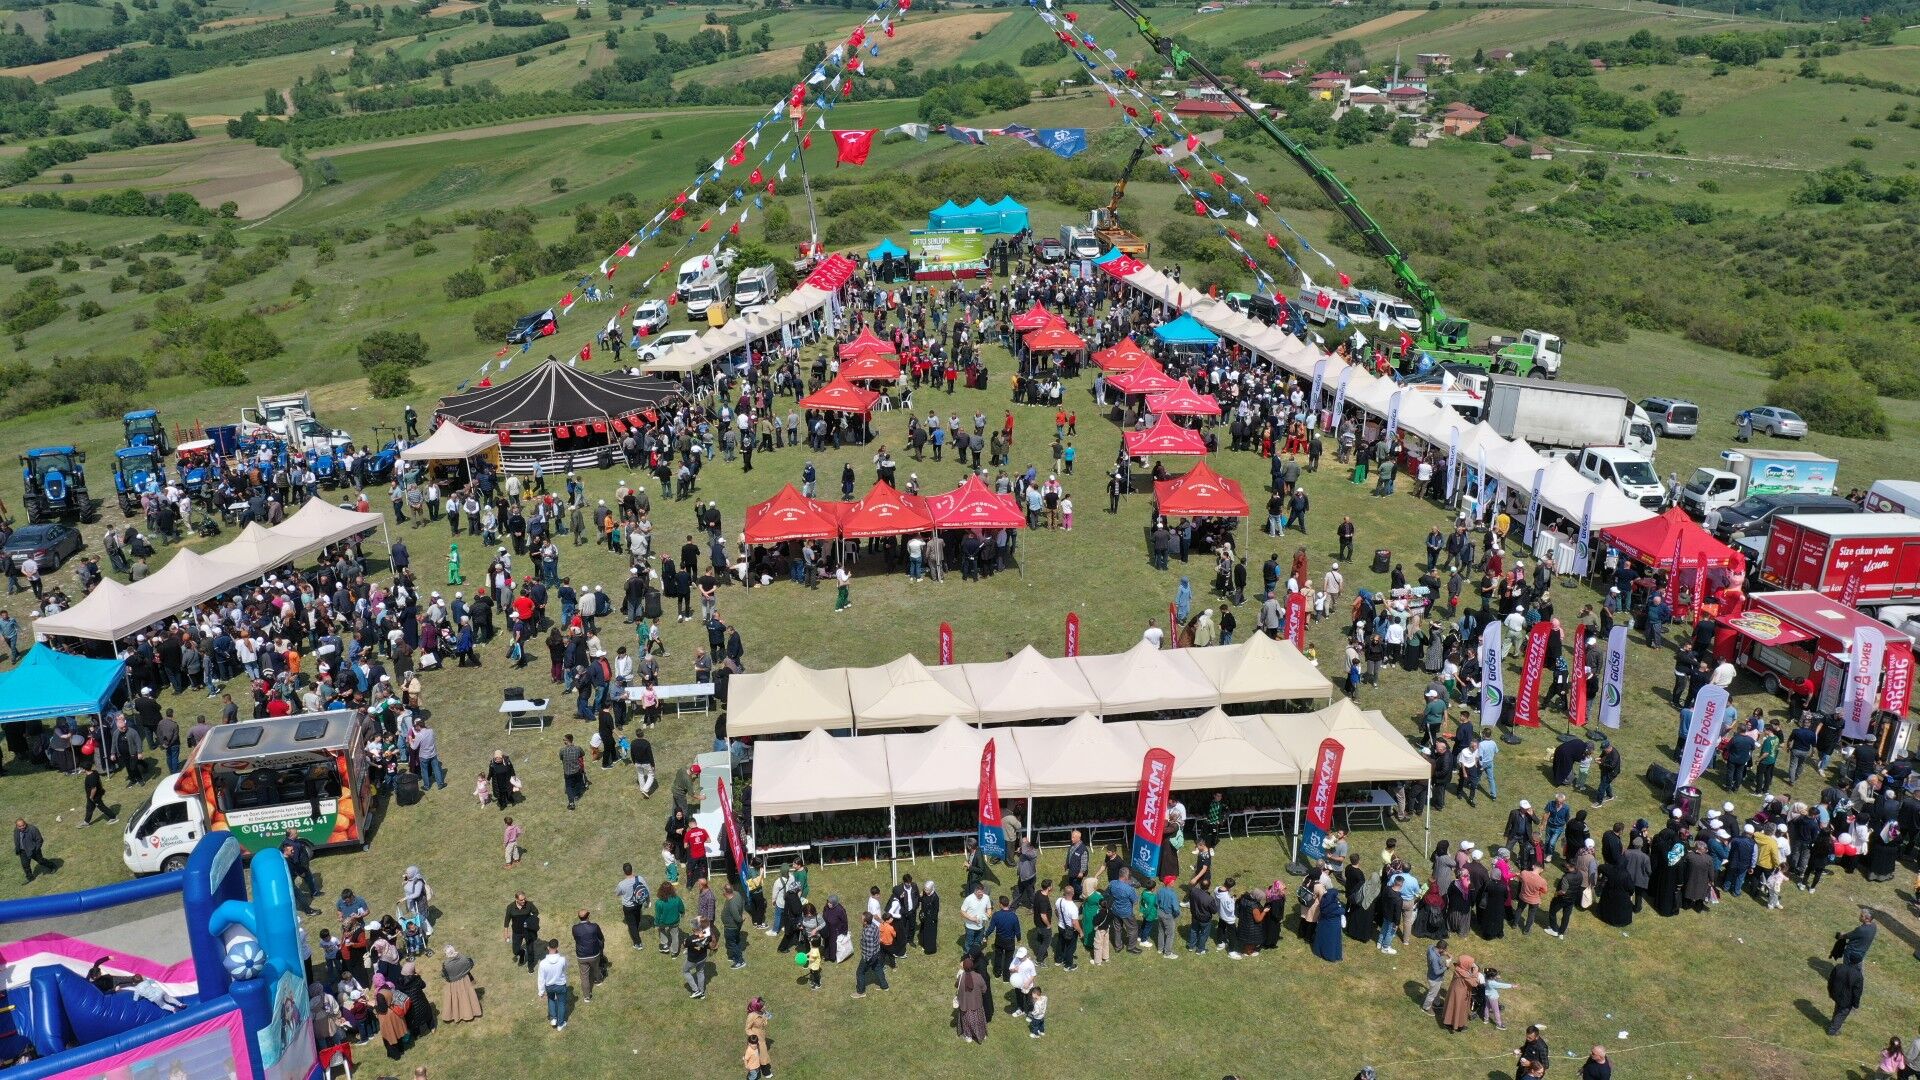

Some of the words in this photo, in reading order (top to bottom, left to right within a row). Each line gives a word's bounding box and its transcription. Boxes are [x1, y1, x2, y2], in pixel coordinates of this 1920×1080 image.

[1839, 546, 1854, 556] Size
[1874, 545, 1895, 557] yollar
[1516, 632, 1542, 721] komagene
[1701, 701, 1716, 735] DÖNER
[252, 821, 279, 833] 0543
[281, 819, 301, 830] 305
[317, 815, 328, 825] 41
